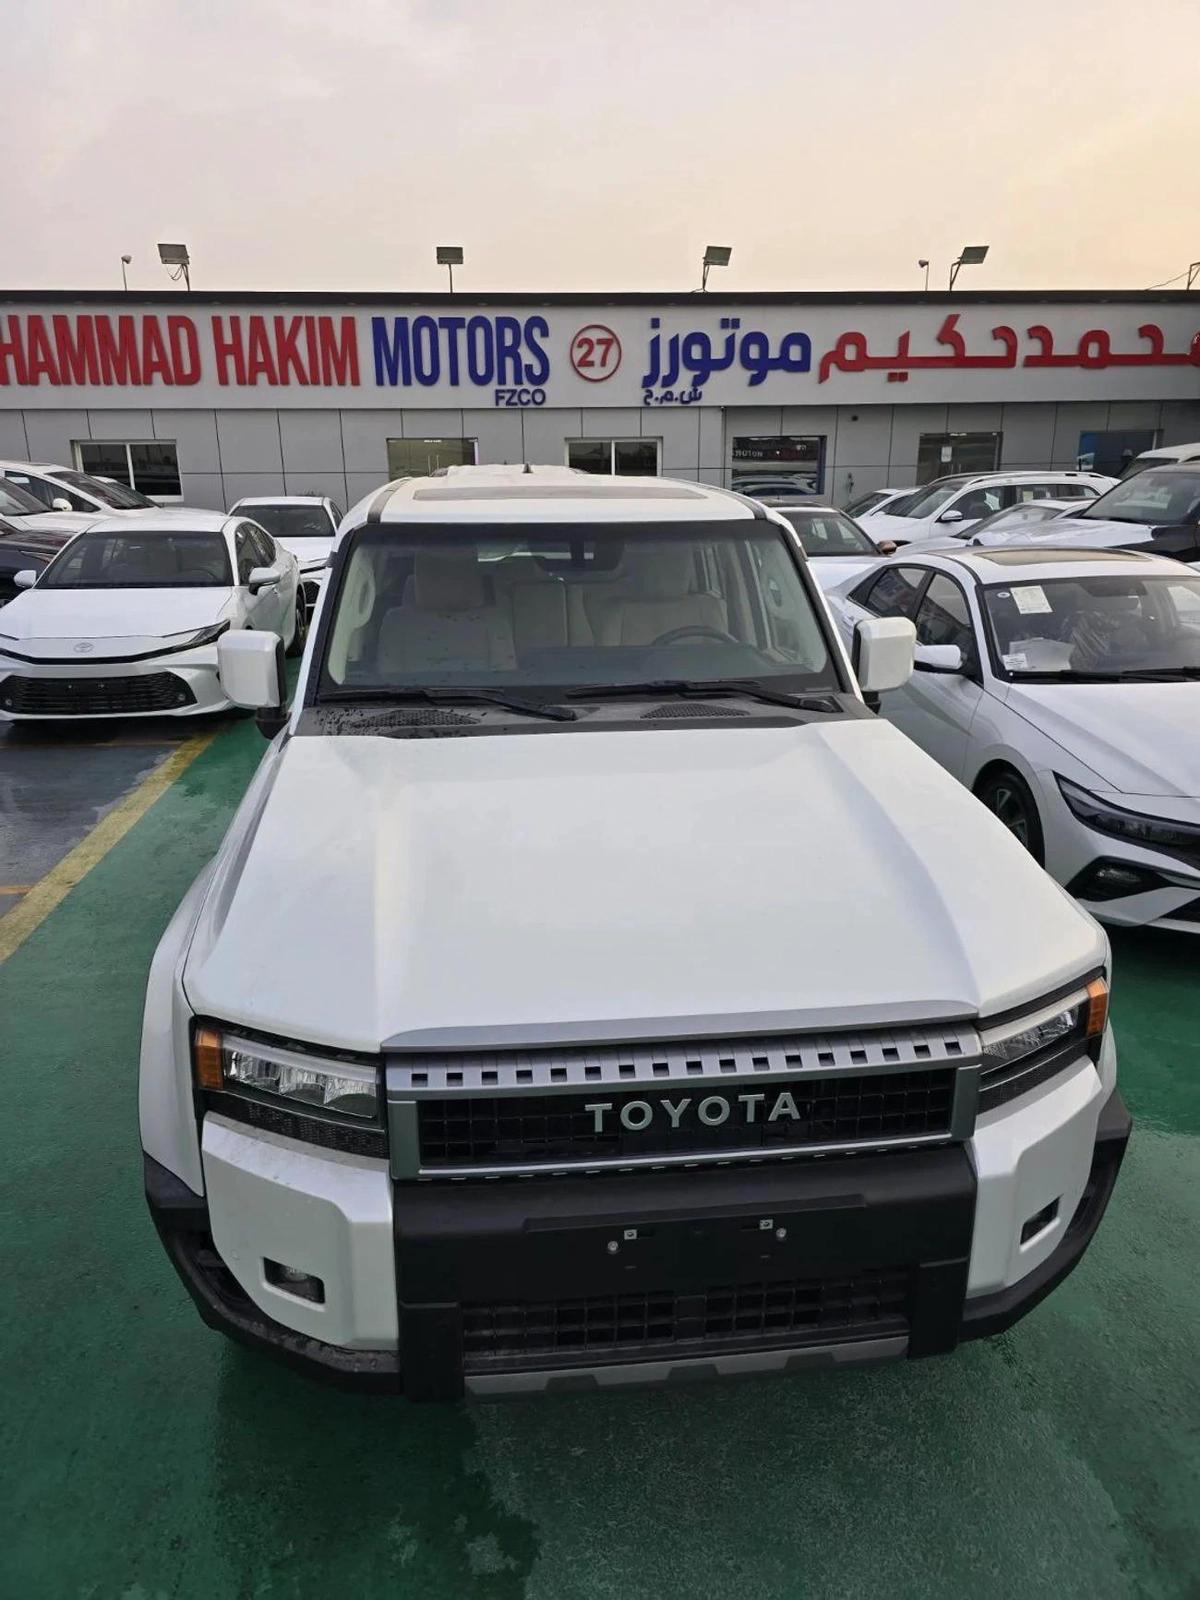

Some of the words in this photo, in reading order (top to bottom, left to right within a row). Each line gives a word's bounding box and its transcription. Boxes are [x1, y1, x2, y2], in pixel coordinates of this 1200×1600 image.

[0, 314, 202, 387] HAMMAD
[210, 315, 361, 387] HAKIM
[371, 315, 550, 387] MOTORS
[576, 338, 614, 367] 27
[641, 317, 812, 388] موتورز
[818, 313, 1018, 384] حكيم
[495, 388, 546, 407] FZCO
[584, 1092, 801, 1133] TOYOTA
